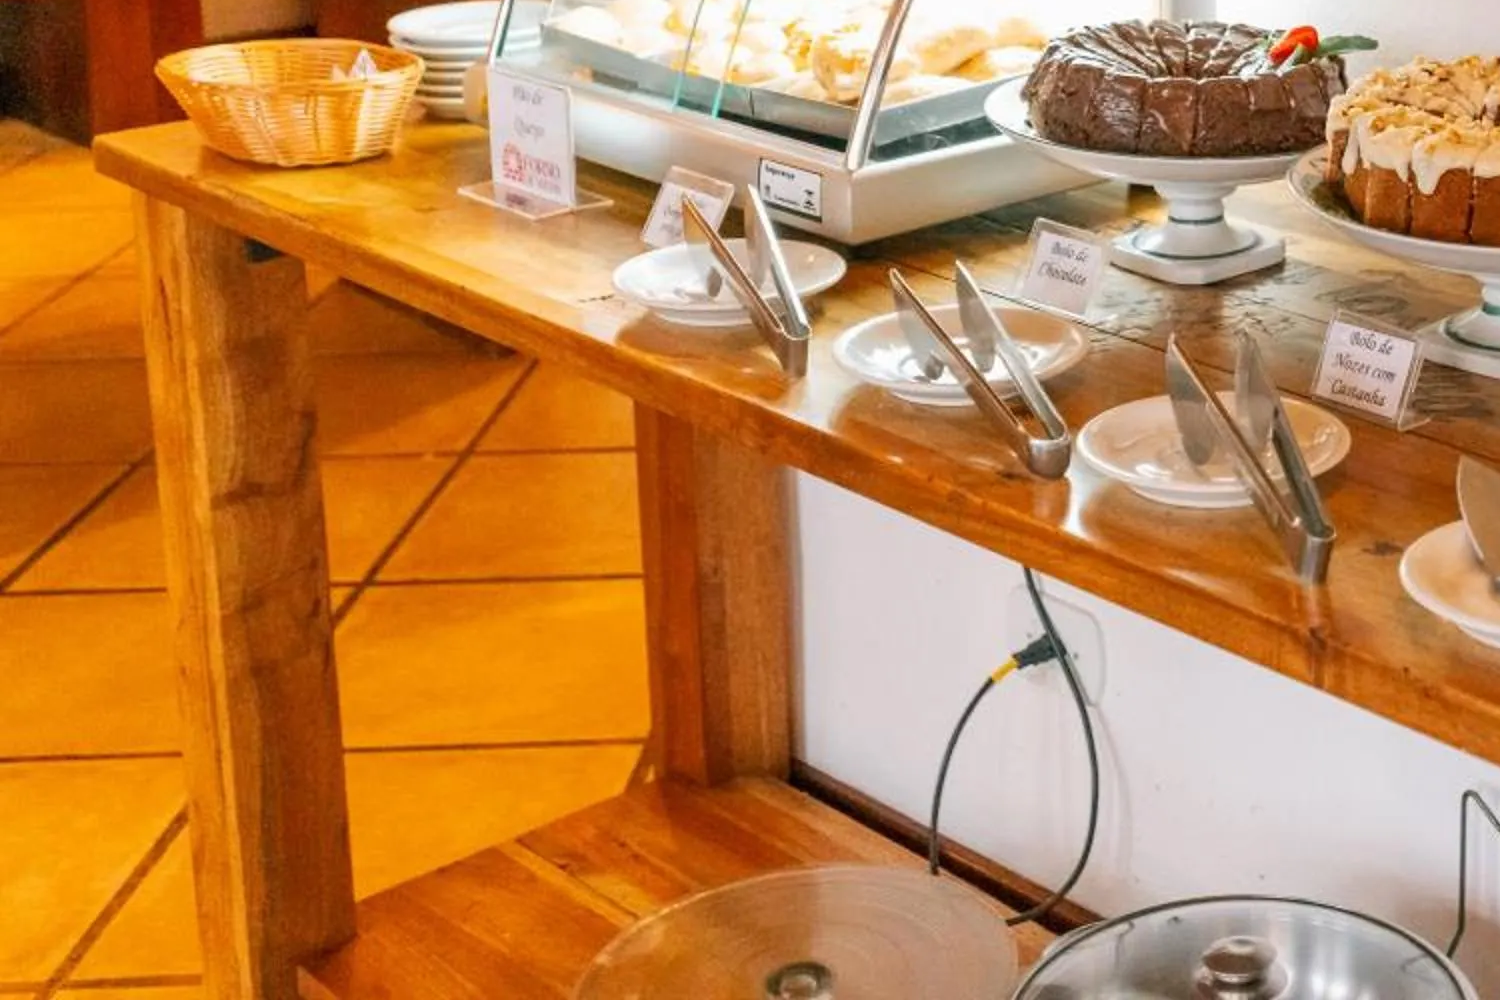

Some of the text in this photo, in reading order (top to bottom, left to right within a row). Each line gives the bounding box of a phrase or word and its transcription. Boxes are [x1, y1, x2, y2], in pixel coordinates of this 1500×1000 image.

[1349, 331, 1393, 355] Bolo de
[1331, 353, 1397, 383] Nozes com
[1328, 379, 1387, 407] Castanha
